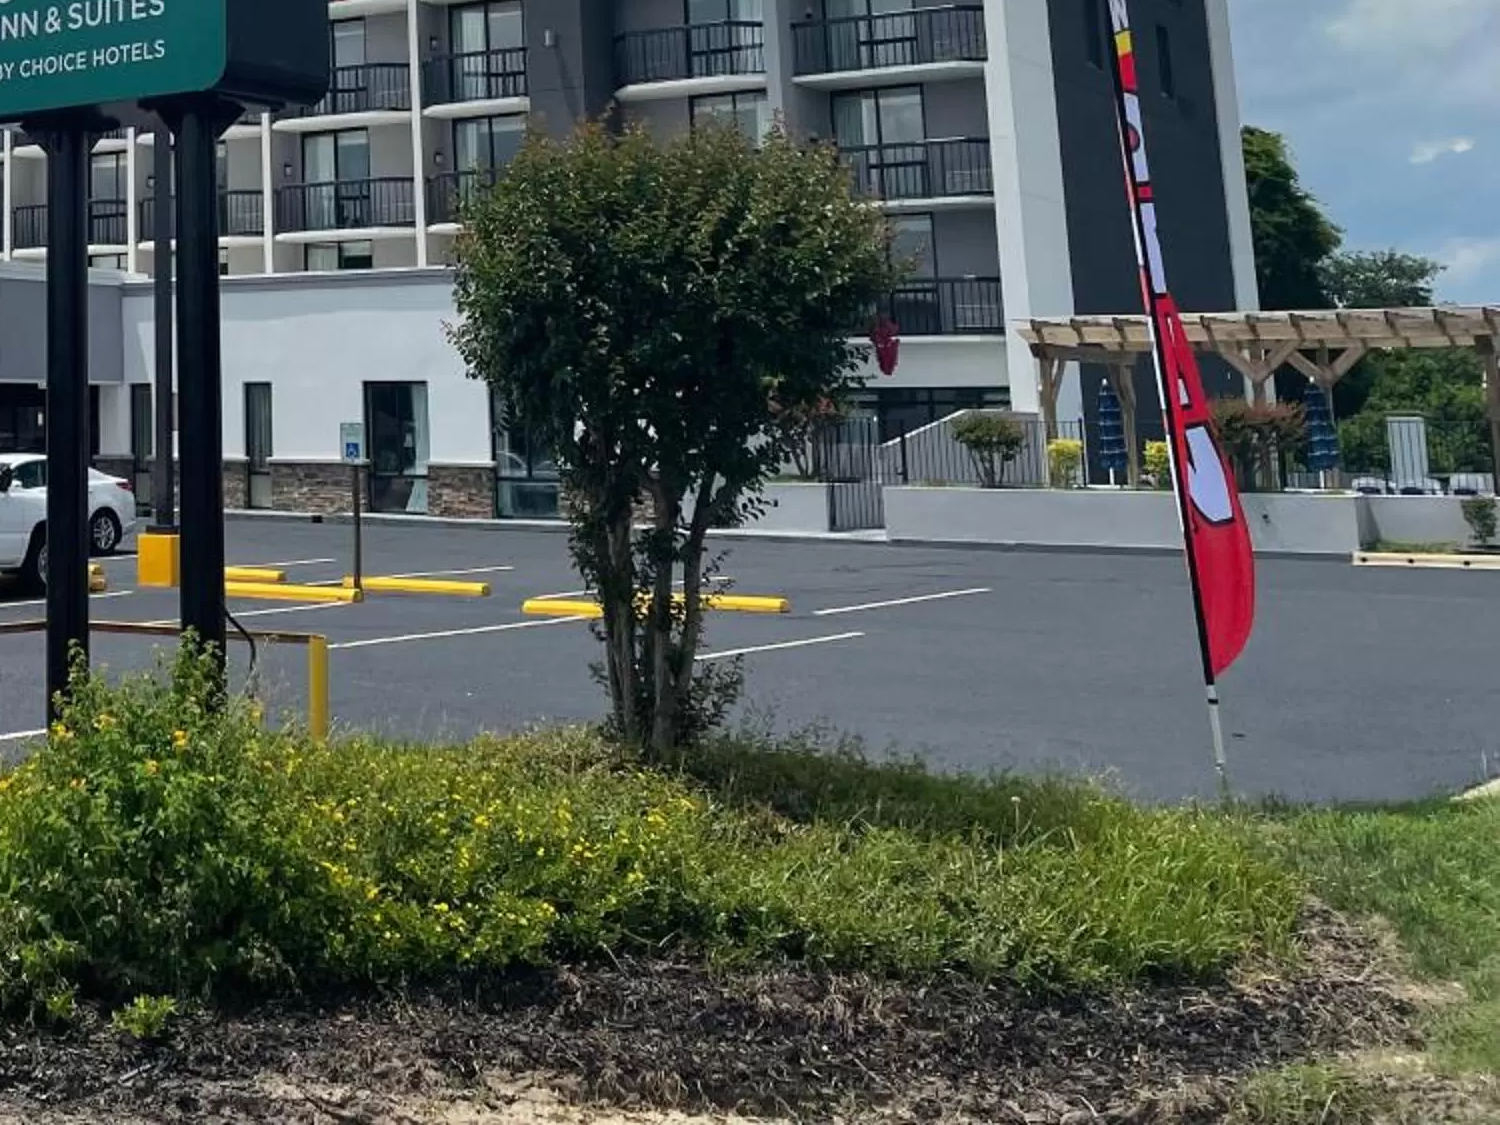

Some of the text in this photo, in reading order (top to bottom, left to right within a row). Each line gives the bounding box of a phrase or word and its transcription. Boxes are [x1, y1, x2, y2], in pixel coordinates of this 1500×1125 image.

[44, 6, 61, 33] &
[19, 46, 87, 77] CHOICE
[93, 39, 165, 67] HOTELS
